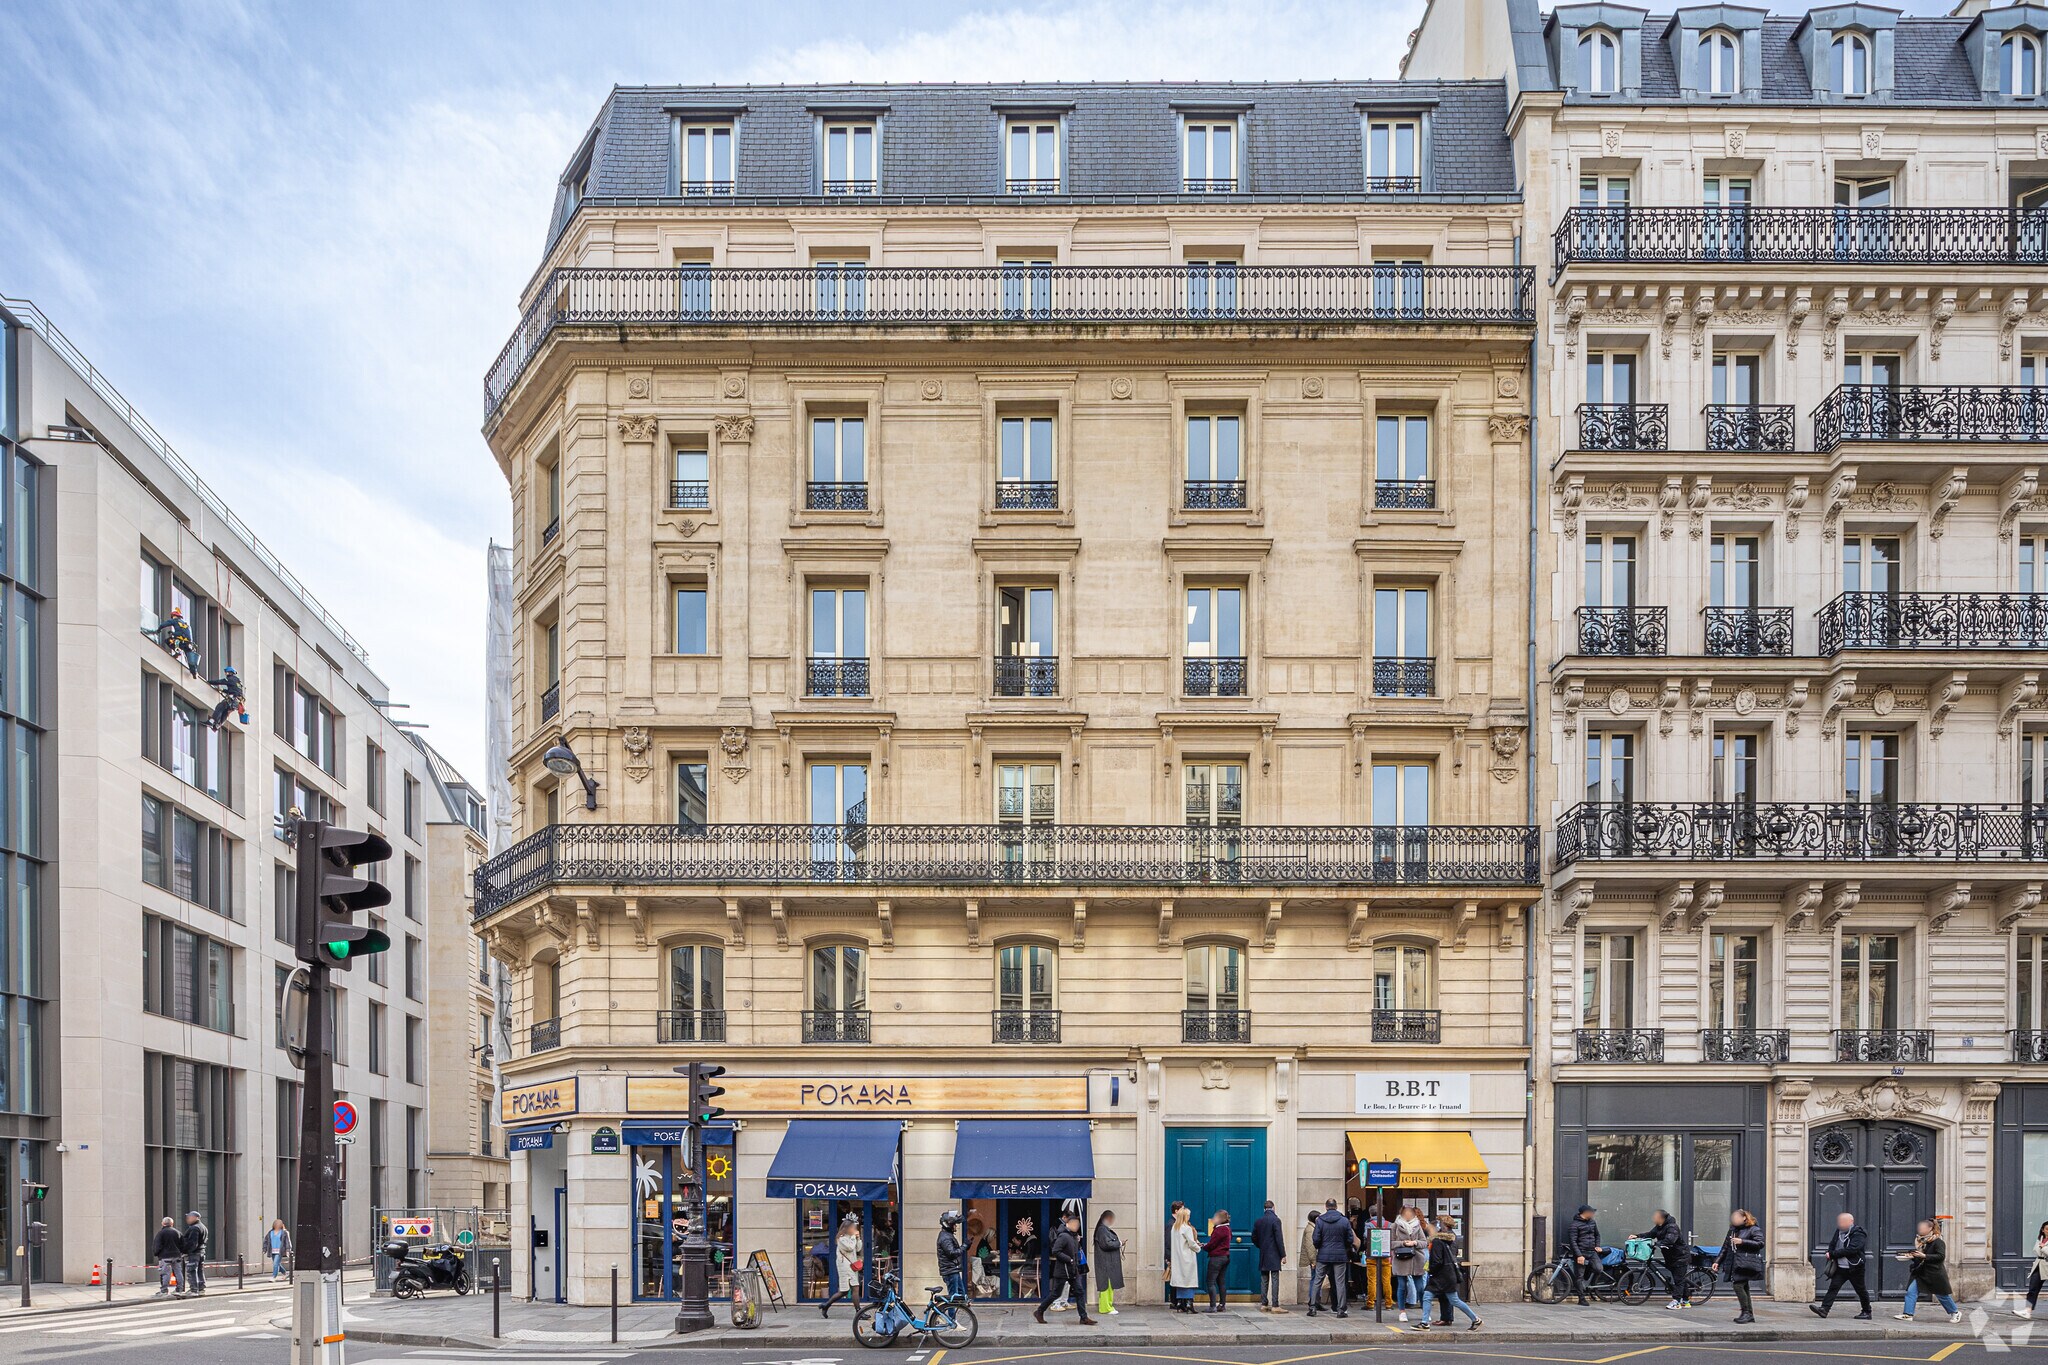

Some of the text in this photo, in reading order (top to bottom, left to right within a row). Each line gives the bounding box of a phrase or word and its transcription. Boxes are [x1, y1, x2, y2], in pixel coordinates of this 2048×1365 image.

[801, 1084, 912, 1106] POKAWA
[1385, 1080, 1440, 1097] B.B.T
[512, 1088, 561, 1115] POKAWA
[518, 1136, 543, 1149] POKAWA
[654, 1131, 680, 1141] POKE
[1426, 1176, 1483, 1184] D'ARTISANS
[794, 1183, 858, 1197] POKAWA
[991, 1184, 1050, 1194] TAKE AWAY
